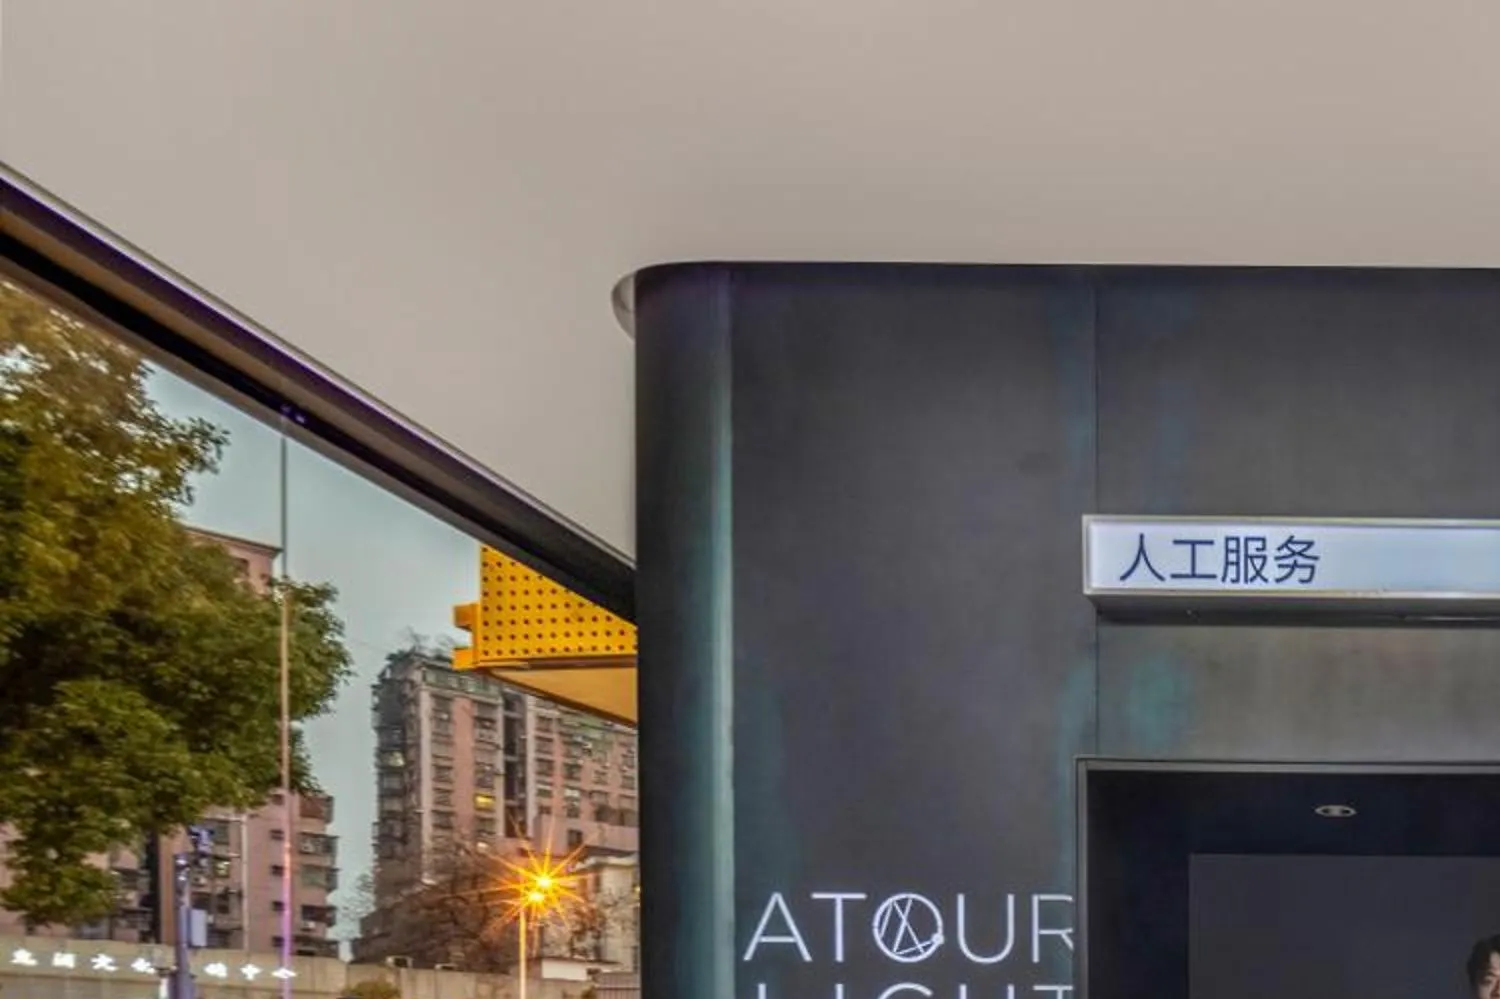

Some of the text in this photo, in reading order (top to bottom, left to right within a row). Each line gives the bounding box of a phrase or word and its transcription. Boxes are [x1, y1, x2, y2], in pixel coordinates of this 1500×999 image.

[1119, 533, 1320, 584] 人工服务
[743, 892, 1074, 963] ATOUR
